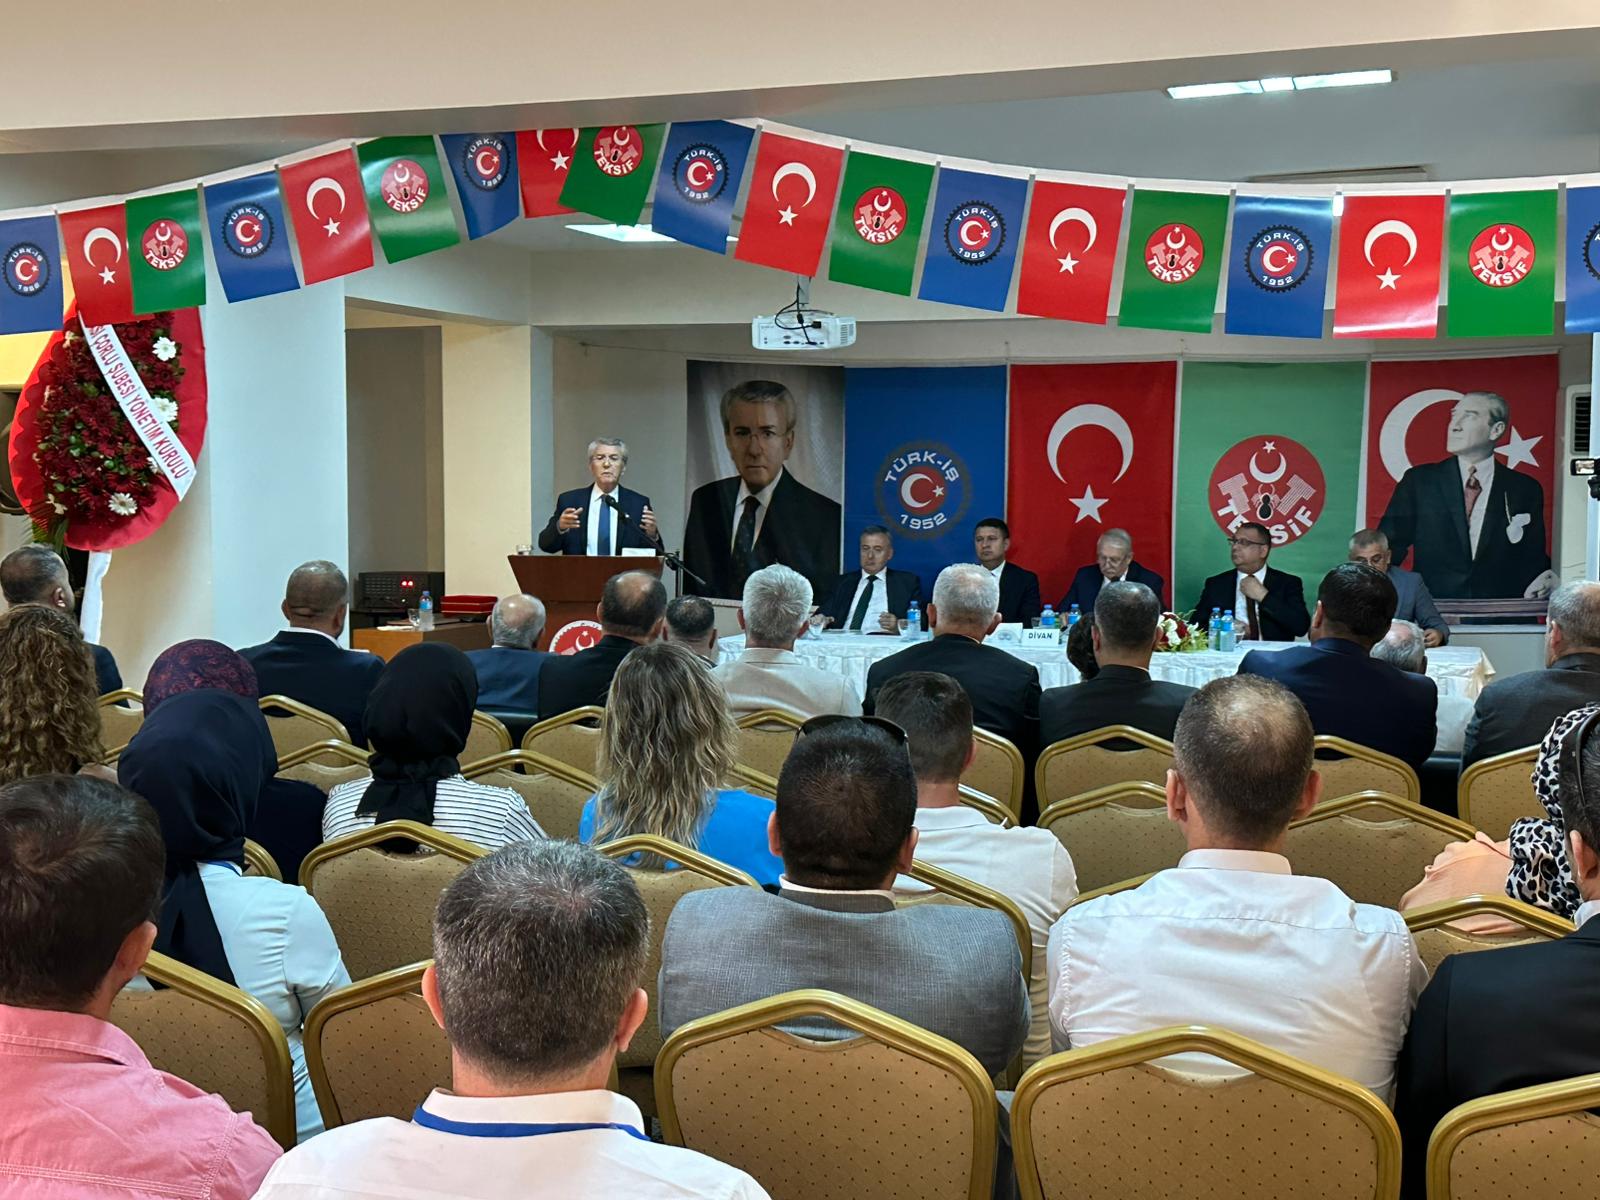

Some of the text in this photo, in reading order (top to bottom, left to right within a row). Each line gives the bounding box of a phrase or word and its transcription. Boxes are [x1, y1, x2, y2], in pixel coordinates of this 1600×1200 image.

[958, 248, 985, 259] 1952
[1262, 276, 1293, 286] 1952
[153, 436, 190, 479] KURULU
[884, 450, 960, 483] TÜRK-İŞ
[900, 512, 947, 530] 1952
[1028, 631, 1052, 640] DİVAN
